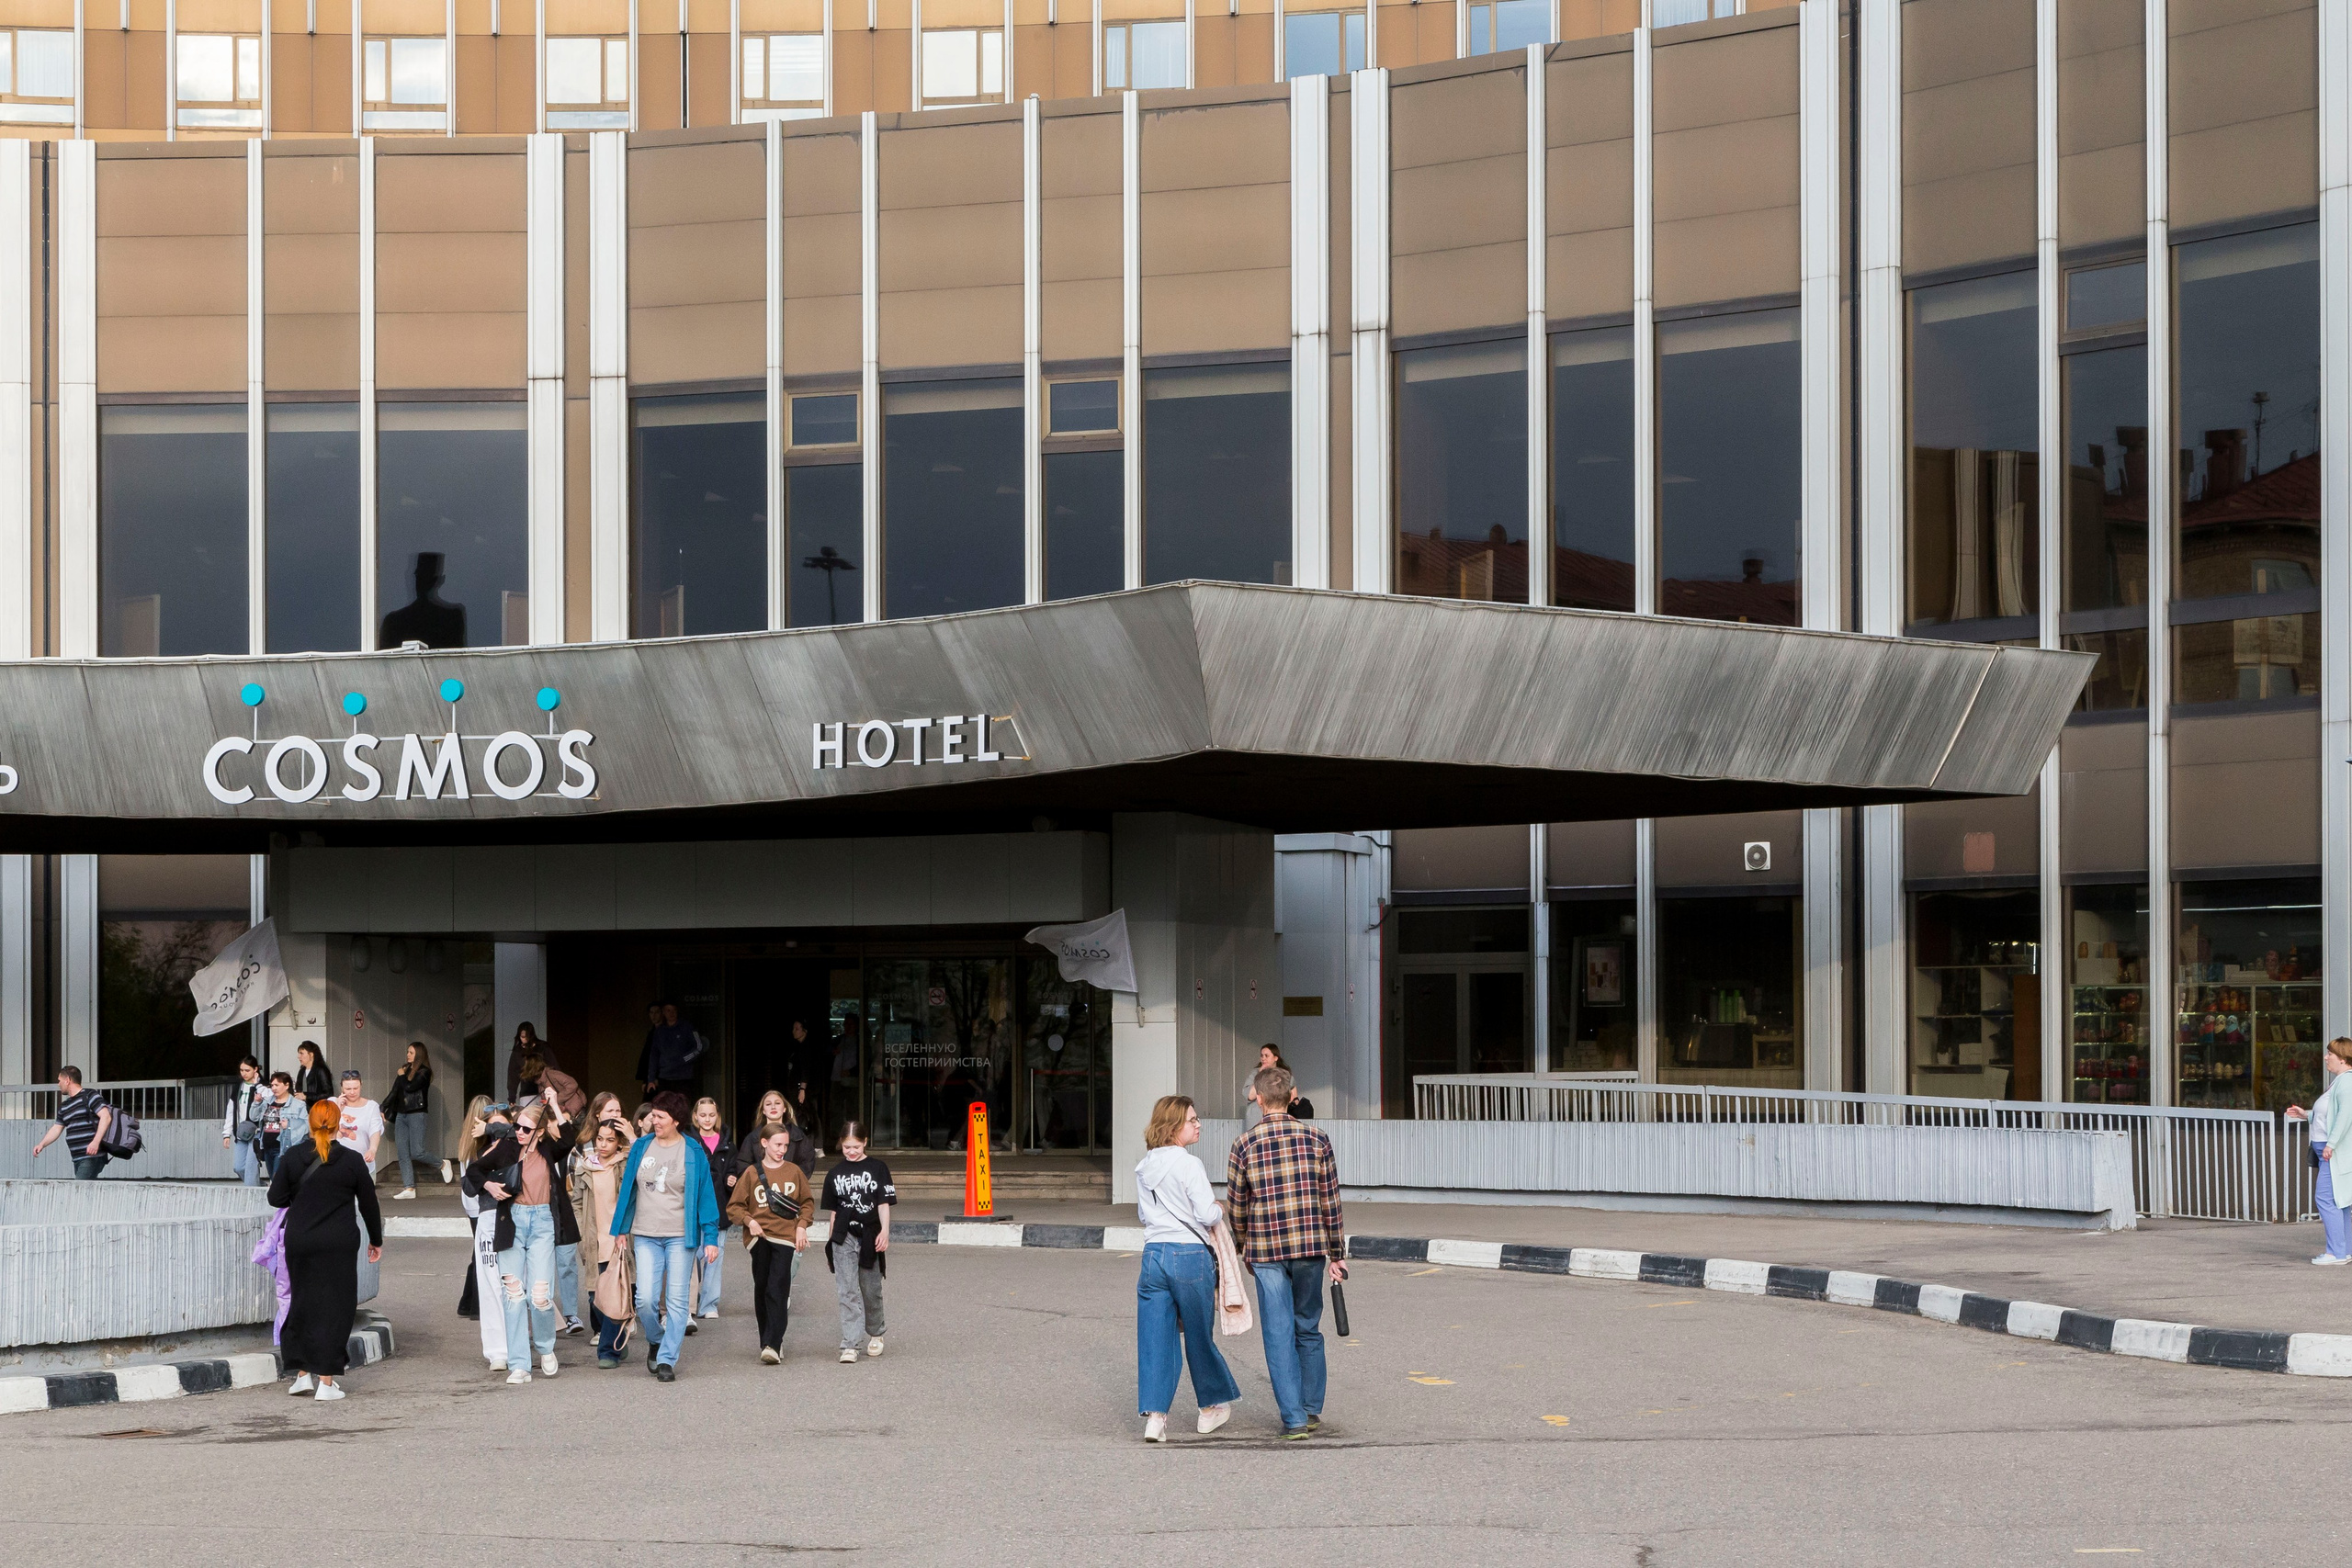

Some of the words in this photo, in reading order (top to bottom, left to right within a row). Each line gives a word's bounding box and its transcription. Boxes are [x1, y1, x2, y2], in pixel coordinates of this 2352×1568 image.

[813, 714, 1002, 769] HOTEL
[203, 729, 597, 804] COSMOS
[885, 1043, 956, 1054] ВСЕЛЕННУЮ
[885, 1057, 991, 1067] ГОСТЕПРИИМСТВА
[978, 1134, 986, 1190] TAXI
[833, 1171, 878, 1196] WEIRDO
